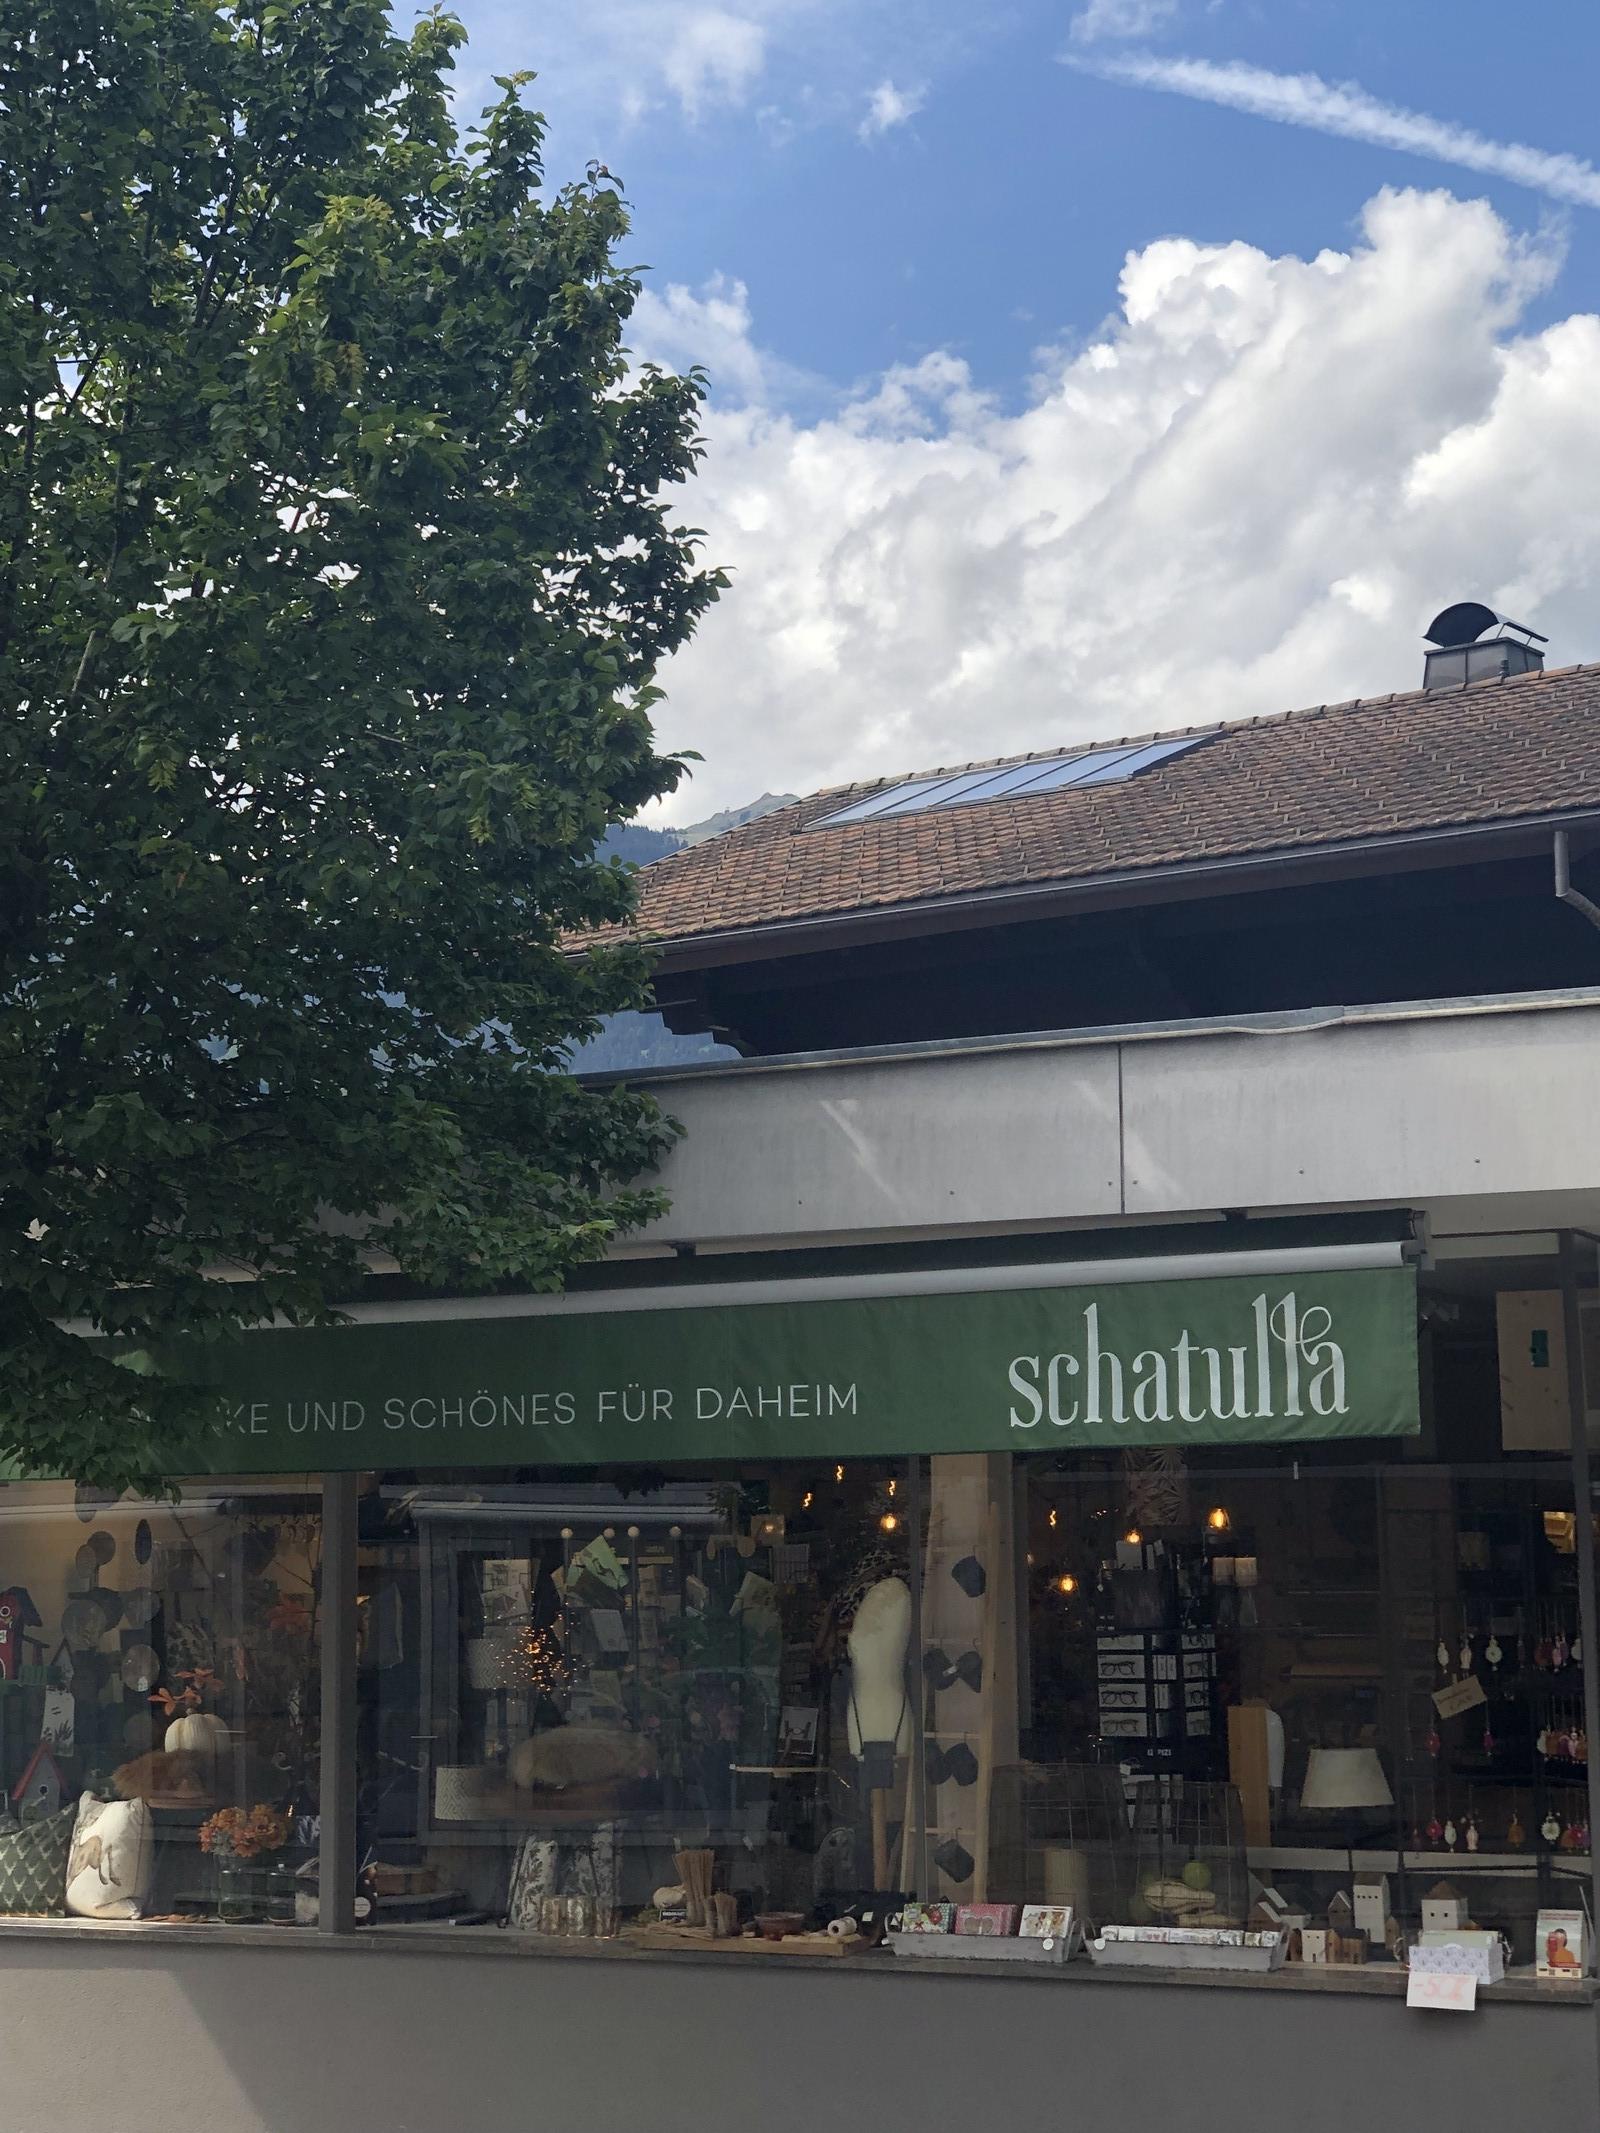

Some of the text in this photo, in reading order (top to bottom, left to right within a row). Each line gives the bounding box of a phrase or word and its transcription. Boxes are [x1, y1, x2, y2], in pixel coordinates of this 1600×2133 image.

[1008, 1291, 1350, 1428] schatulla
[212, 1382, 858, 1435] KE UND SCHÖNES FÜR DAHEIM
